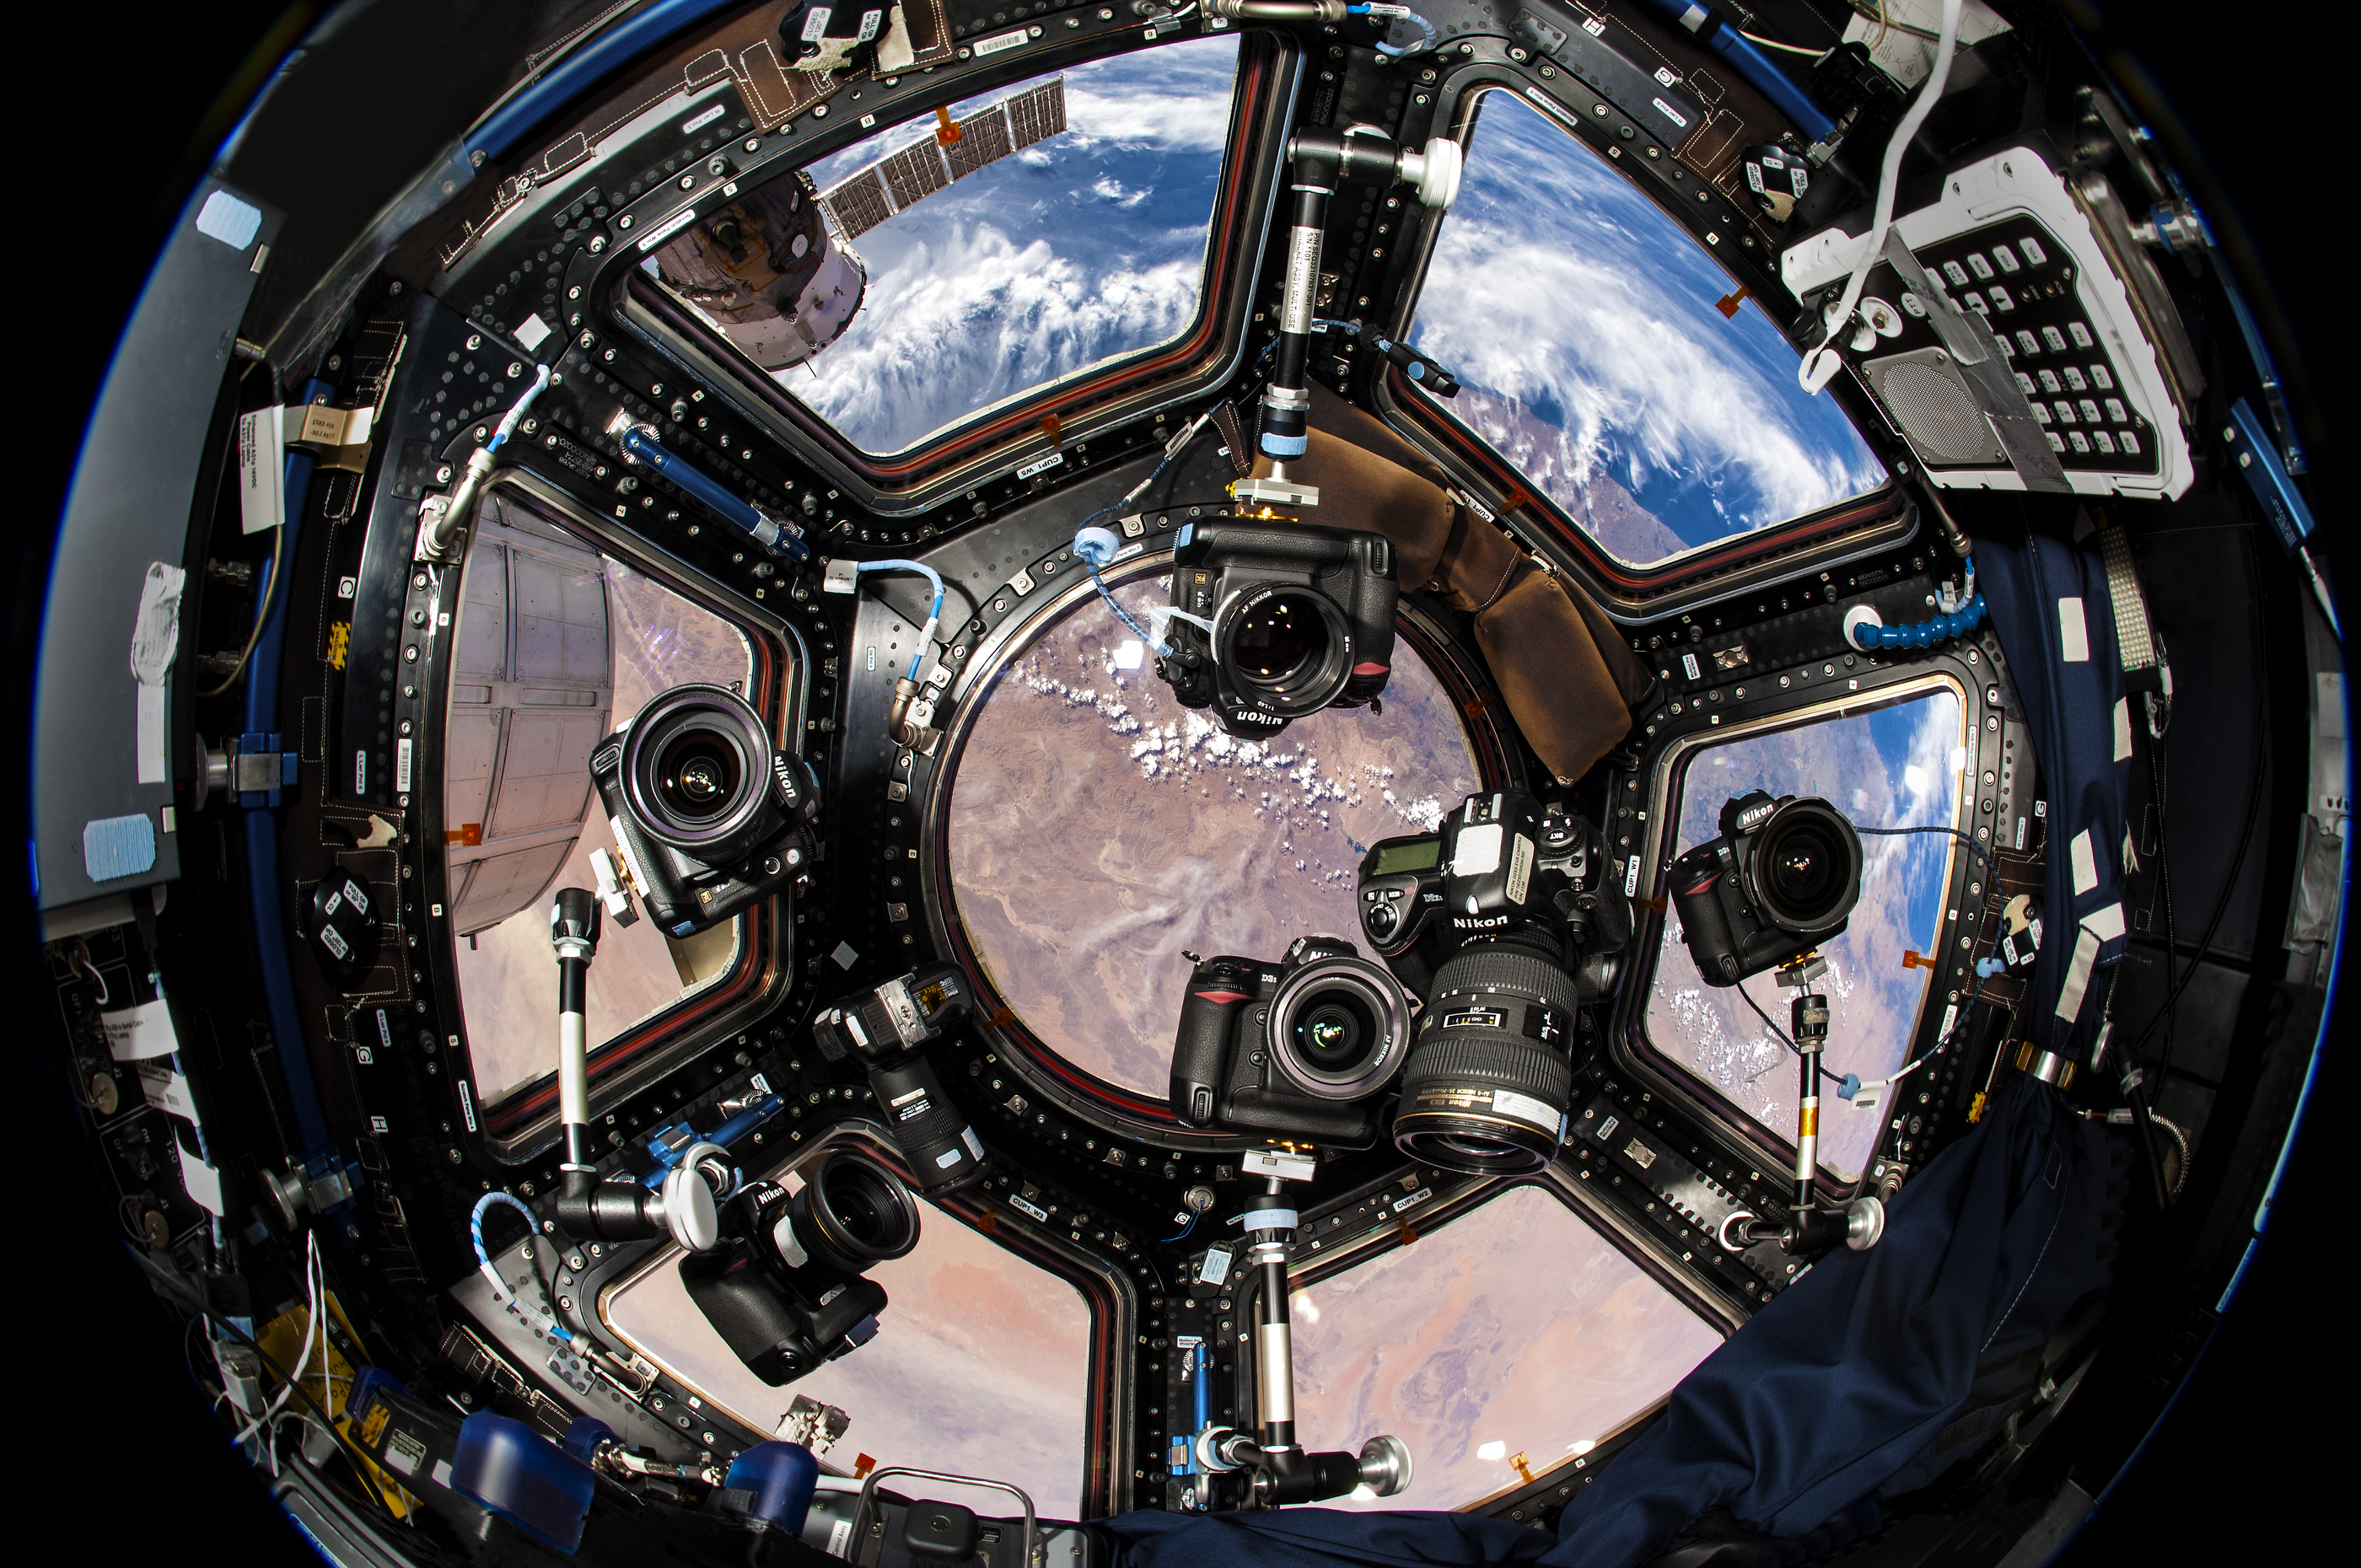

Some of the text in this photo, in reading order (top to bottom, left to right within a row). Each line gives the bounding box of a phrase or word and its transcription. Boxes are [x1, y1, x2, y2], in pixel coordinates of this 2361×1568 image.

[820, 9, 826, 19] OP
[869, 13, 879, 29] FULL
[806, 12, 819, 37] CLOSED
[1585, 19, 1601, 35] H
[1658, 70, 1672, 83] G
[1557, 107, 1574, 123] Scratch
[670, 212, 691, 228] Scratch
[657, 226, 670, 236] Pane
[2026, 245, 2036, 260] VOL
[1974, 260, 1986, 276] MON
[2000, 254, 2011, 268] VOX
[1306, 246, 1318, 306] SEG33107631-301
[1947, 267, 1958, 283] TALK
[1951, 265, 1966, 282] LSTN
[1905, 298, 1922, 315] PTT
[2018, 336, 2030, 352] HANG
[2025, 338, 2034, 348] UP
[2043, 334, 2056, 351] CONF
[2050, 331, 2063, 349] LSTN
[2074, 330, 2085, 343] 2nd
[1999, 341, 2011, 354] ANS
[2096, 372, 2106, 385] CLR
[1853, 362, 1897, 429] AUDIO TERMINAL
[1021, 456, 1058, 476] CUP1 W5
[1472, 503, 1490, 520] CUP1
[341, 579, 353, 595] C
[1250, 590, 1272, 606] NIKKOR
[1237, 711, 1283, 725] Nikon
[775, 755, 797, 798] Nikon
[1742, 804, 1774, 824] Nikon
[2036, 803, 2045, 814] G
[348, 883, 359, 896] FULL
[327, 903, 334, 911] CL
[1452, 915, 1509, 929] Nikon
[324, 933, 342, 955] CLOSED
[358, 1048, 370, 1062] G
[1374, 1044, 1388, 1066] NIKKOR
[113, 1066, 122, 1079] J2
[1449, 1098, 1472, 1108] Nikon
[372, 1118, 386, 1130] H
[165, 1140, 179, 1164] 120
[758, 1186, 785, 1205] Nikon
[1397, 1190, 1429, 1209] CUP1_W2
[1013, 1197, 1044, 1219] CUP1_W3
[1177, 1213, 1188, 1223] G
[832, 1525, 847, 1555] Control Assy
